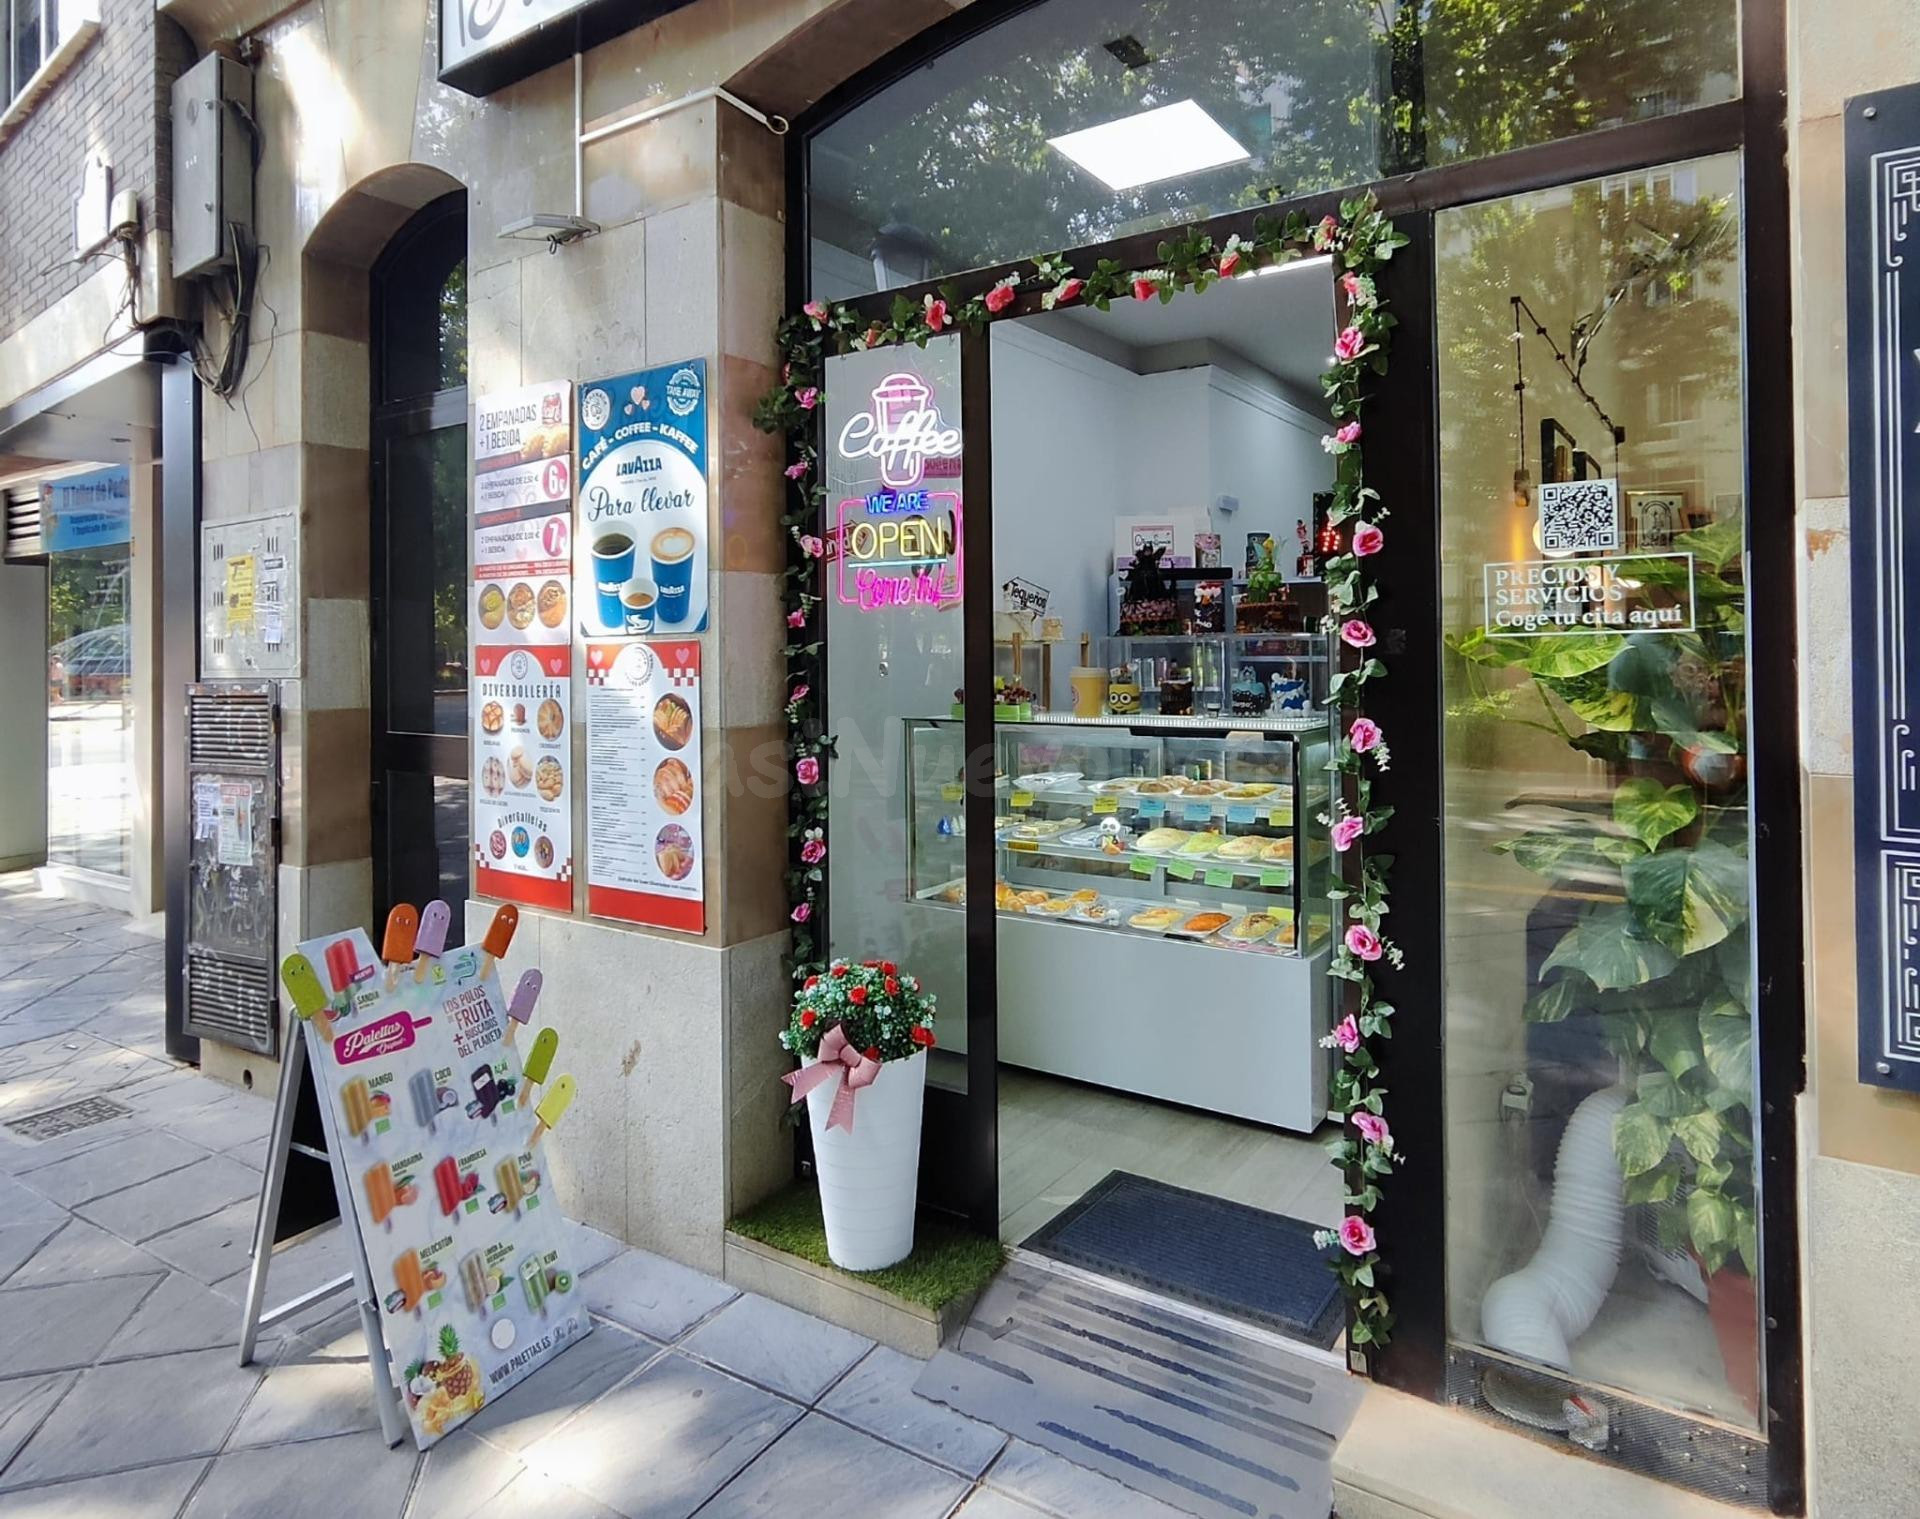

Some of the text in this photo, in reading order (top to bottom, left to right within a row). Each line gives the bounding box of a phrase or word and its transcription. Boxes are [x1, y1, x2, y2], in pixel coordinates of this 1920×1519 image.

[479, 404, 537, 432] 2 EMPANADAS
[491, 429, 521, 450] BEBIDA
[582, 436, 608, 470] CAFÉ
[615, 422, 651, 440] COFFEE
[660, 424, 699, 454] KAFFEE
[839, 410, 962, 471] Coffee
[616, 456, 662, 476] LAVAZZA
[588, 486, 695, 522] Para llevar
[866, 490, 930, 515] WE ARE
[851, 517, 944, 559] OPEN
[1495, 564, 1620, 586] PRECIOS Y
[856, 568, 912, 611] Come
[1495, 585, 1623, 606] SERVICIOS
[1495, 604, 1682, 631] Coge tu cita aquí
[482, 681, 560, 698] DIVERBOLLERÍA
[442, 985, 486, 1015] LOS POLOS
[454, 999, 494, 1030] FRUTA
[343, 1021, 402, 1058] Palettas
[453, 1033, 463, 1045] +
[465, 1017, 498, 1040] BUSCADOS
[458, 1027, 503, 1058] DEL PLANETA
[368, 1072, 393, 1088] MANGO
[434, 1067, 452, 1081] COCO
[391, 1152, 423, 1172] MANDARINA
[459, 1148, 487, 1166] FRAMBUESA
[518, 1151, 532, 1164] PIÑA
[419, 1235, 453, 1259] MELOCOTÓN
[489, 1336, 552, 1384] WWW.PALETTAS.ES
